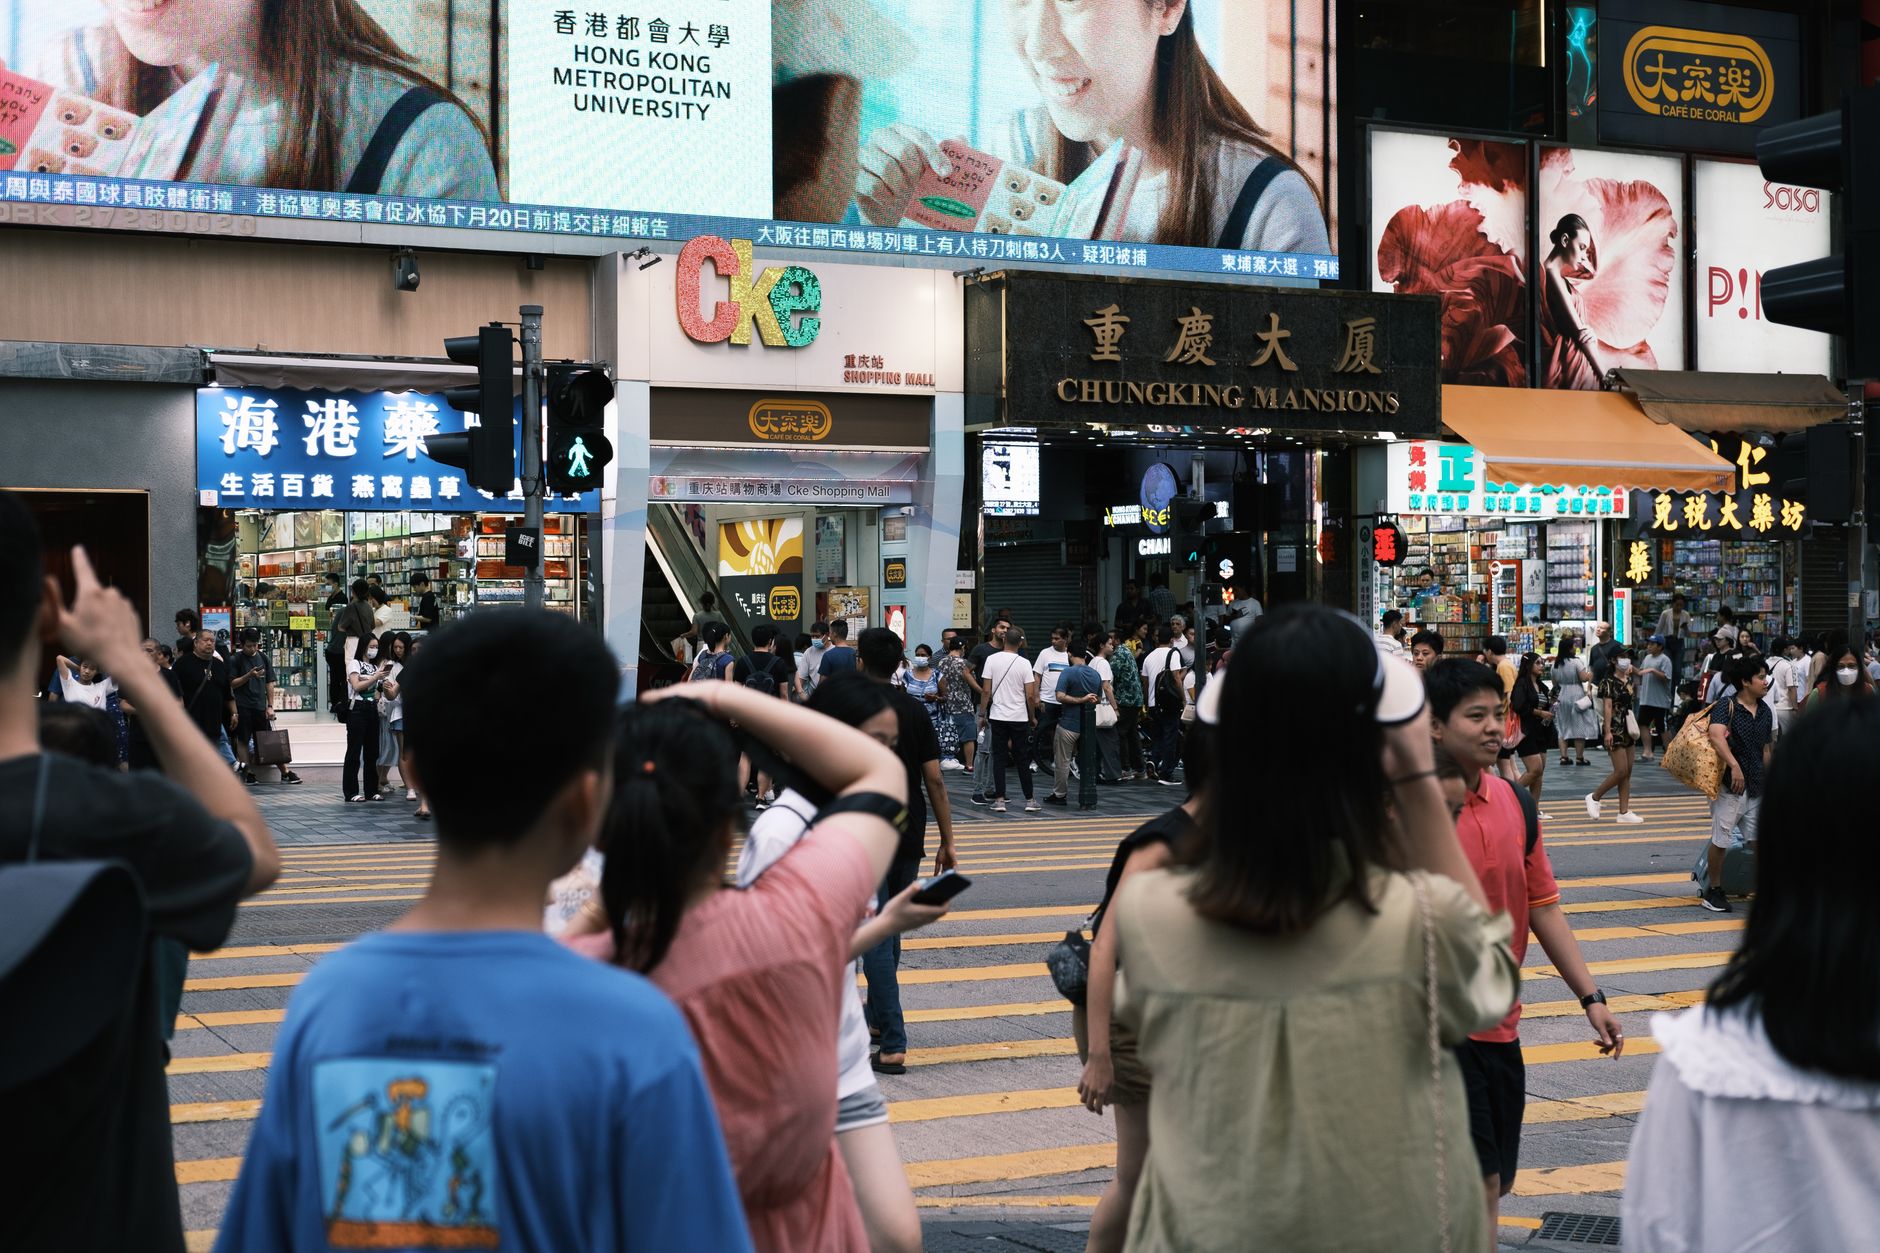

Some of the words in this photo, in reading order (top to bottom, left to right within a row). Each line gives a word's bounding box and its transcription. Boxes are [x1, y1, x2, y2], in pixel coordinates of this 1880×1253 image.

[554, 10, 730, 48] 香港都會大學
[574, 44, 640, 67] HONG
[649, 51, 711, 73] KONG
[553, 67, 731, 99] METROPOLITAN
[574, 94, 710, 121] UNIVERSITY
[1690, 107, 1704, 119] DE
[1705, 109, 1738, 123] CORAL
[676, 235, 821, 347] Cke
[1709, 266, 1760, 320] P!
[844, 354, 883, 369] 重庆站
[844, 371, 901, 385] SHOPPING
[905, 373, 935, 387] MALL
[1057, 378, 1245, 409] CHUNGKING
[1252, 386, 1399, 414] MANSIONS
[220, 472, 334, 499] 生活百貨
[689, 481, 782, 497] 重庆站購物商場
[787, 484, 809, 496] Cke
[812, 485, 864, 499] Shopping
[867, 486, 890, 497] Mall
